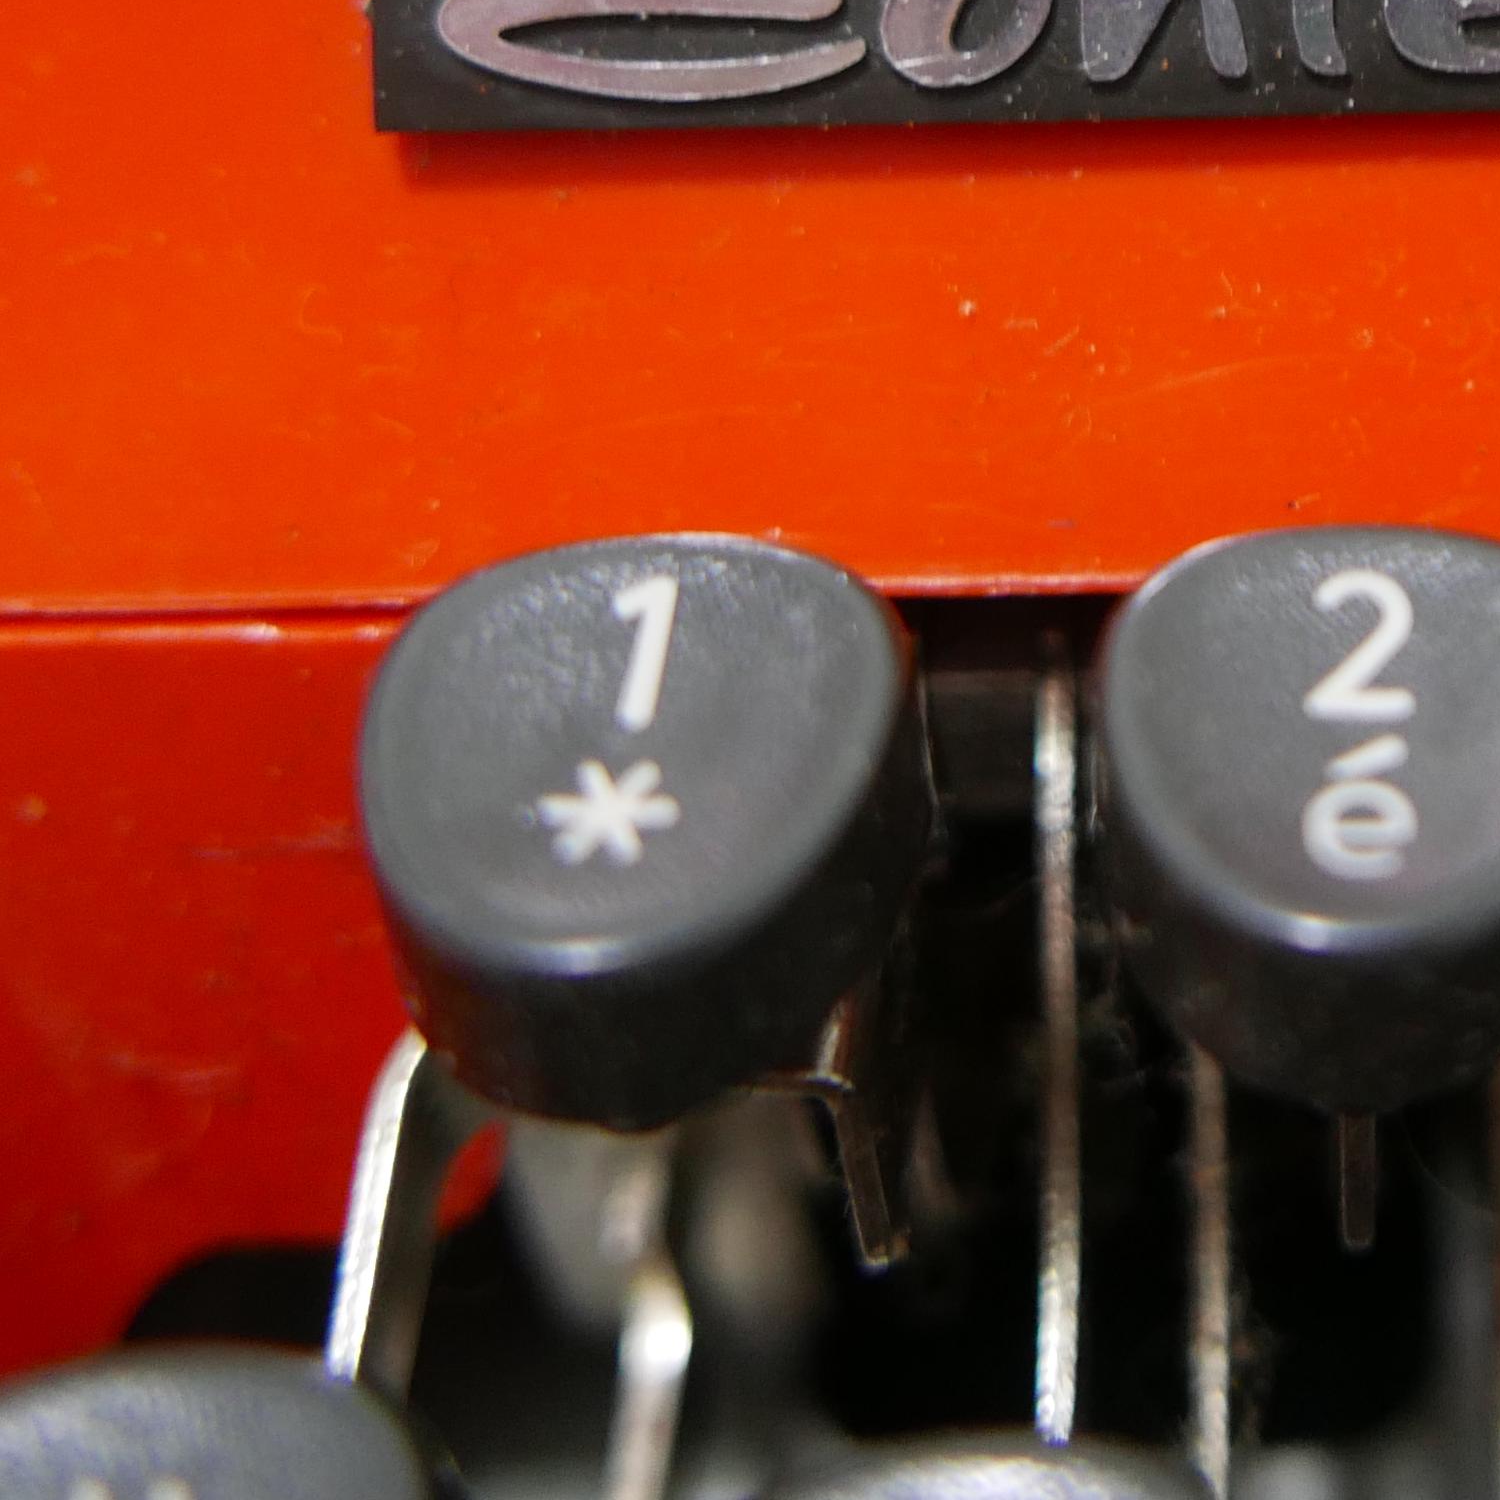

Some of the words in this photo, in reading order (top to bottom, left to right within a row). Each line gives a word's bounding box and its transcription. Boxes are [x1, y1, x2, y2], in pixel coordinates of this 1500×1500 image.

[613, 574, 679, 732] 1
[1303, 569, 1417, 721] 2
[1303, 733, 1418, 880] é
